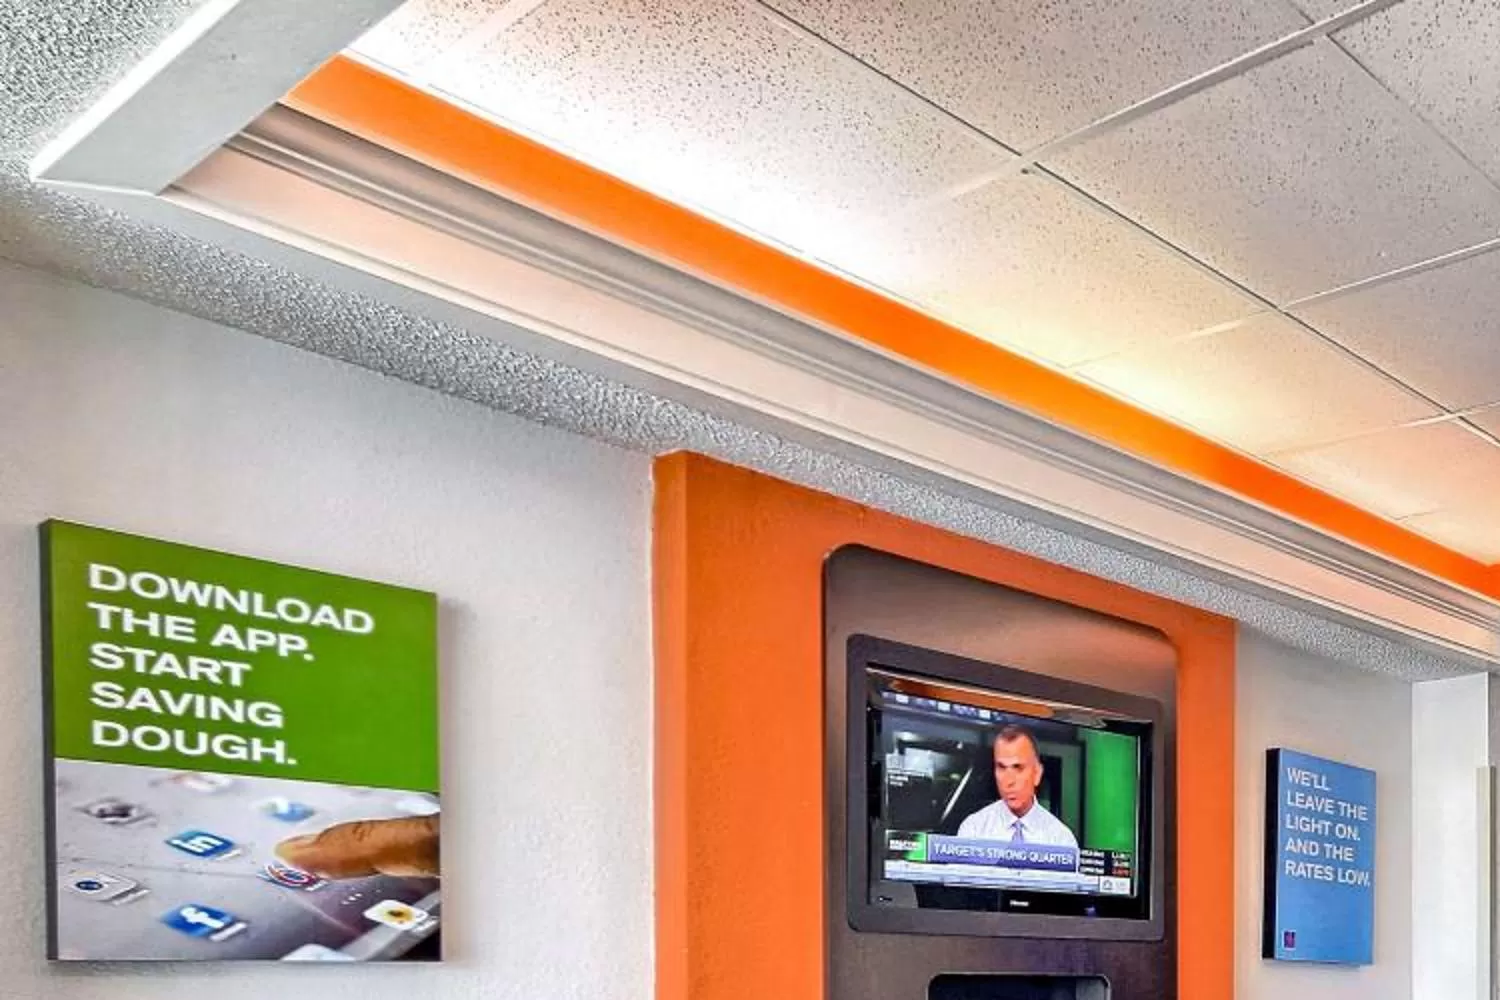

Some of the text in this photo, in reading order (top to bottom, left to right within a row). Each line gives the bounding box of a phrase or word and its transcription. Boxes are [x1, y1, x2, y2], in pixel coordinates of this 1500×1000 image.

[88, 562, 374, 634] DOWNLOAD
[88, 602, 314, 661] THE APP.
[90, 642, 252, 687] START
[90, 682, 284, 729] SAVING
[92, 720, 297, 765] DOUGH.
[1287, 768, 1330, 791] WE'LL
[1287, 792, 1368, 821] LEAVE THE
[1286, 814, 1361, 841] LIGHT ON.
[987, 848, 1027, 861] STRONG
[1029, 851, 1074, 865] QUARTER
[1285, 838, 1354, 861] AND THE
[1285, 860, 1333, 882] RATES
